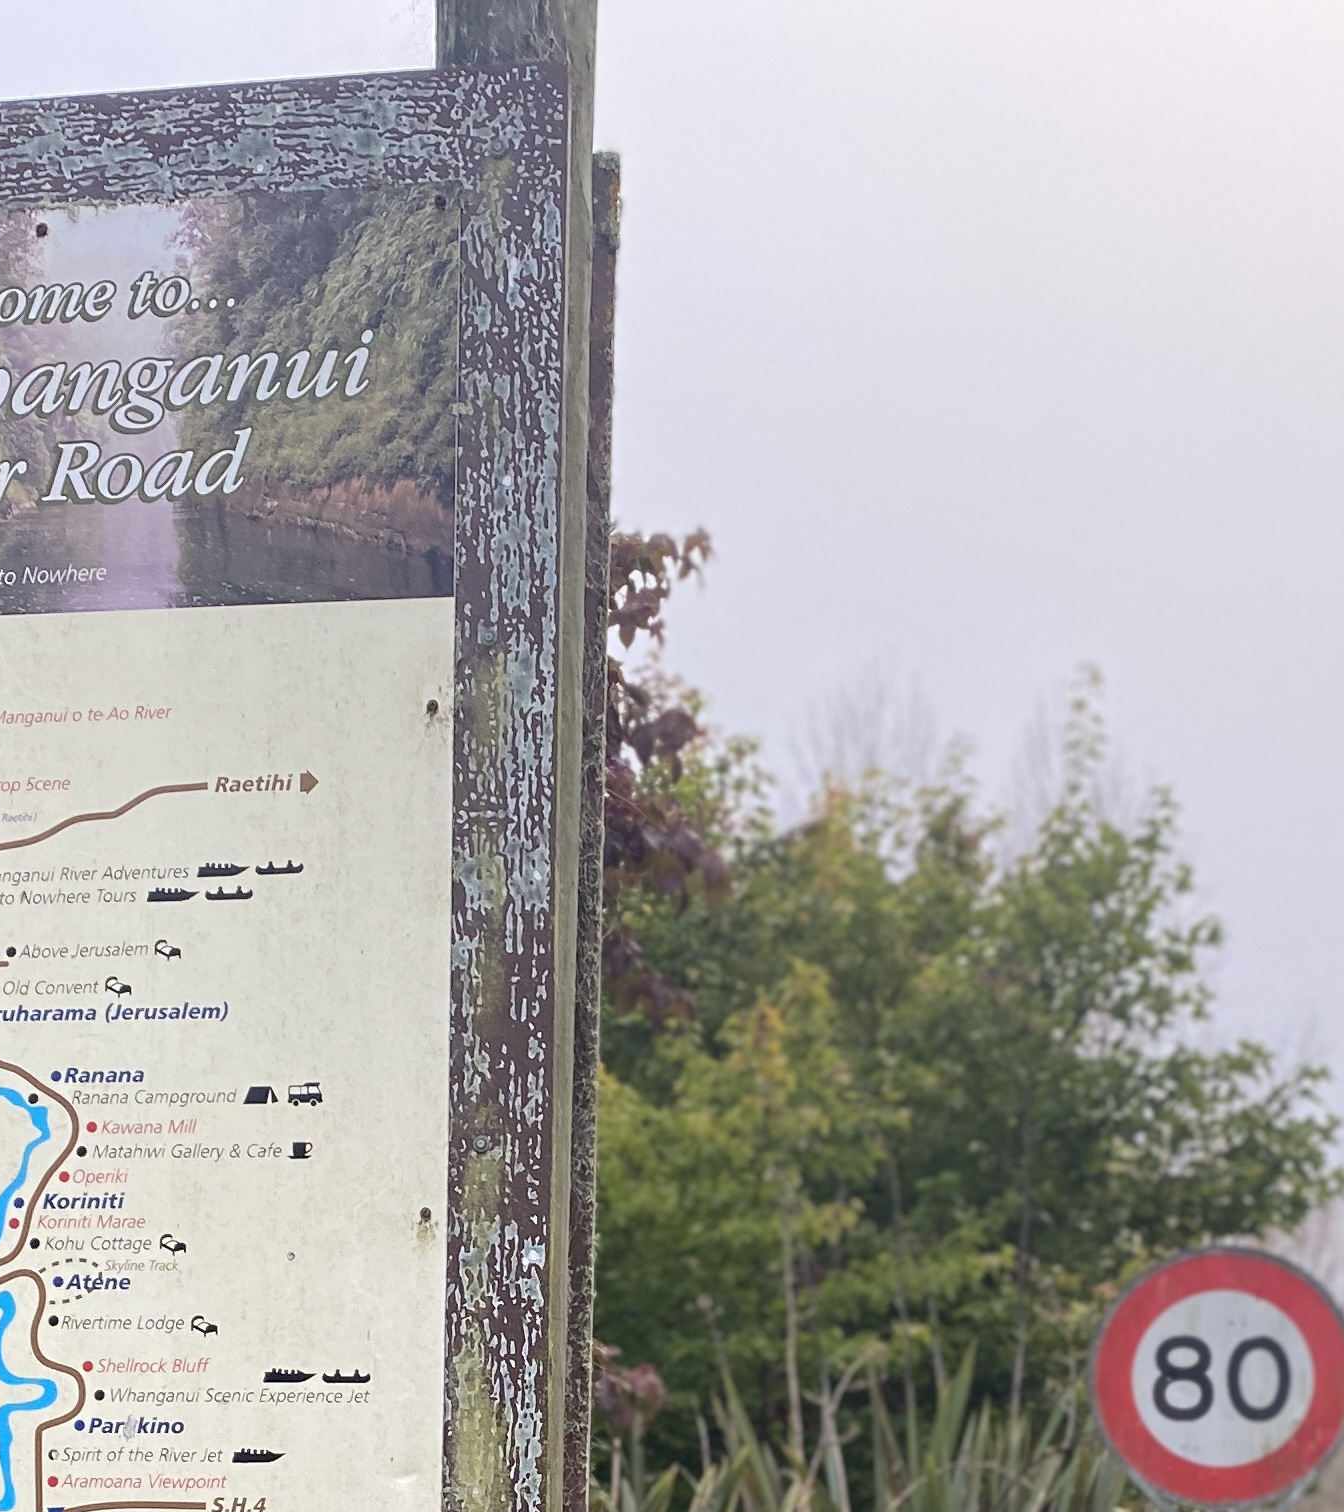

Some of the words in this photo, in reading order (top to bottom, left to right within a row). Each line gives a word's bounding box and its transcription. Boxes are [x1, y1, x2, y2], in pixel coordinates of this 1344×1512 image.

[131, 270, 235, 316] to...
[44, 428, 253, 504] Road
[0, 568, 15, 585] to
[22, 563, 107, 583] Nowhere
[71, 712, 83, 721] o
[86, 709, 104, 721] te
[108, 707, 129, 721] Ao
[134, 706, 172, 720] River
[26, 776, 70, 792] Scene
[214, 774, 292, 792] Raetihi
[61, 867, 97, 881] River
[103, 865, 189, 880] Adventures
[0, 891, 14, 905] to
[21, 890, 92, 905] Nowhere
[97, 889, 136, 903] Tours
[19, 944, 68, 958] Above
[72, 942, 148, 958] Jerusalem
[3, 981, 29, 996] Old
[34, 980, 99, 995] Convent
[105, 1001, 229, 1023] (Jerusalem)
[64, 1068, 144, 1083] Ranana
[72, 1091, 128, 1105] Ranana
[134, 1087, 237, 1107] Campground
[101, 1121, 163, 1134] Kawana
[168, 1119, 197, 1134] Mill
[92, 1144, 165, 1159] Matahiwi
[171, 1144, 224, 1161] Gallery
[229, 1145, 241, 1158] &
[246, 1143, 282, 1158] Cafe
[73, 1169, 128, 1186] Operiki
[43, 1192, 125, 1209] Koriniti
[37, 1215, 92, 1230] Koriniti
[96, 1216, 146, 1229] Marae
[44, 1236, 84, 1251] Kohu
[91, 1237, 152, 1254] Cottage
[104, 1259, 145, 1275] Skyline
[66, 1274, 130, 1290] Atene
[61, 1316, 131, 1331] Rivertime
[137, 1316, 185, 1333] Lodge
[97, 1358, 167, 1373] Shellrock
[172, 1358, 209, 1373] Bluff
[1153, 1335, 1291, 1422] 80
[110, 1388, 199, 1406] Whanganui
[205, 1389, 254, 1404] Scenic
[259, 1390, 343, 1406] Experience
[346, 1389, 370, 1404] Jet
[88, 1418, 184, 1435] Parkino
[61, 1448, 101, 1464] Spirit
[106, 1448, 123, 1462] of
[128, 1448, 154, 1462] the
[158, 1448, 196, 1462] River
[199, 1449, 223, 1463] Jet
[61, 1475, 142, 1489] Aramoana
[148, 1475, 227, 1491] Viewpoint
